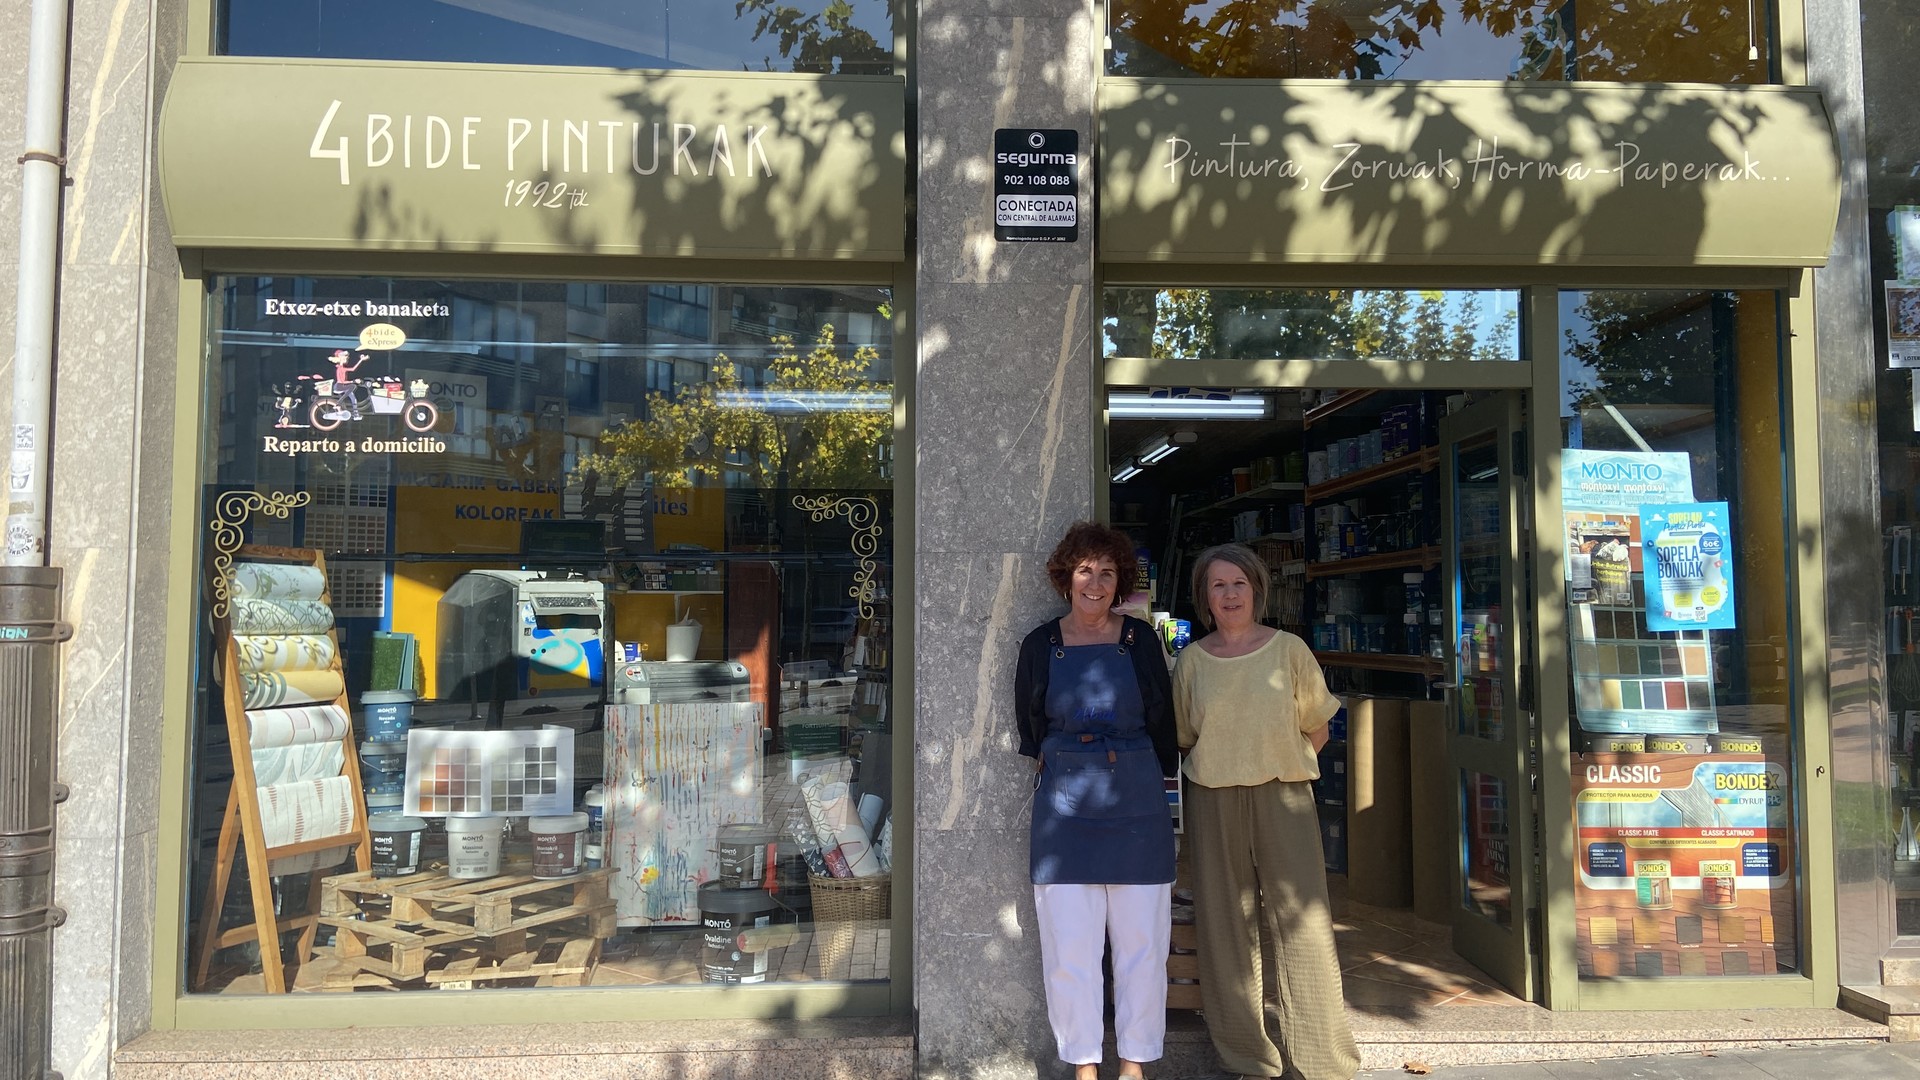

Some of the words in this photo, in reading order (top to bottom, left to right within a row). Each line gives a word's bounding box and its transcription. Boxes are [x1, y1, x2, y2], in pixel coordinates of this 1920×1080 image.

[308, 99, 350, 185] 4
[366, 113, 482, 170] BIDE
[507, 118, 773, 178] PINTURAK
[997, 152, 1077, 168] segurma
[1163, 133, 1309, 191] Pintura,
[1319, 142, 1460, 192] Zoruak,
[1003, 174, 1024, 185] 902
[1027, 175, 1047, 186] 108
[1049, 175, 1070, 186] 088
[504, 178, 567, 209] 1992
[998, 199, 1075, 212] CONECTADA
[997, 213, 1012, 221] CON
[1012, 213, 1038, 222] CENTRAL
[1038, 214, 1047, 222] DE
[1047, 214, 1075, 222] ALARMAS
[265, 298, 361, 317] Etxez-etxe
[365, 300, 450, 318] banaketa
[429, 381, 477, 398] ONTO
[263, 436, 340, 458] Reparto
[345, 440, 356, 453] a
[361, 437, 446, 454] domicilio
[1581, 461, 1663, 481] MONTO
[1580, 481, 1621, 494] montoxyl
[1623, 482, 1666, 494] montoxyl
[455, 504, 555, 521] KOLOREAK
[1656, 545, 1700, 563] SOPELA
[1657, 561, 1704, 578] BONUAK
[1610, 740, 1644, 752] BONDE
[1586, 764, 1661, 784] CLASSIC
[1714, 770, 1780, 790] BONDEX
[704, 918, 732, 929] MONTÓ
[704, 933, 732, 944] Ovaldine
